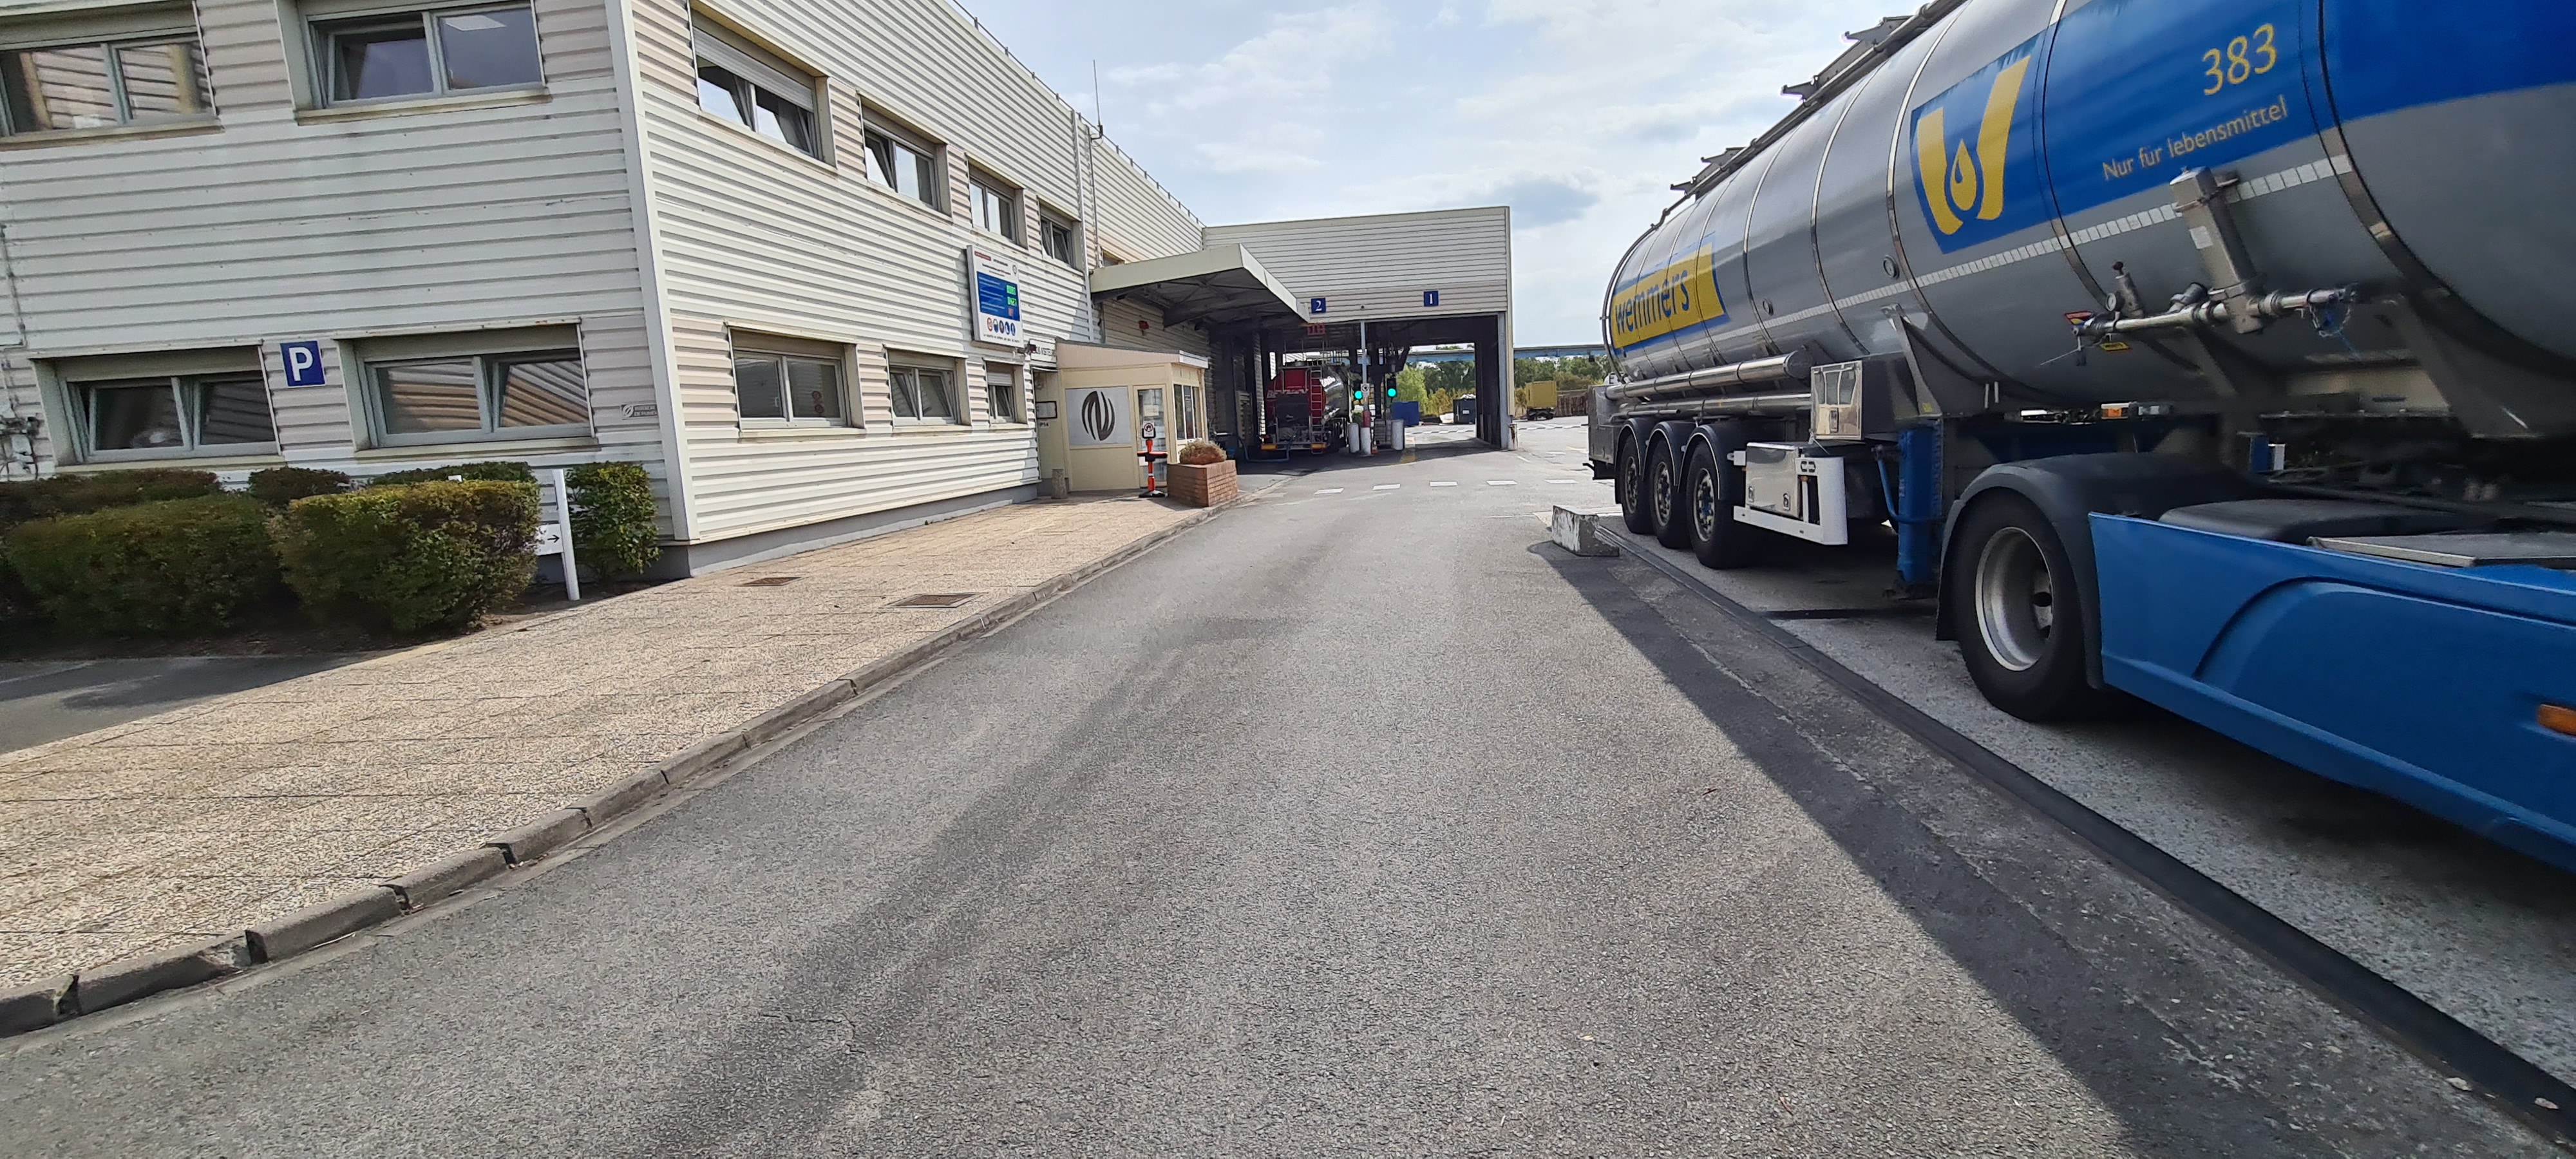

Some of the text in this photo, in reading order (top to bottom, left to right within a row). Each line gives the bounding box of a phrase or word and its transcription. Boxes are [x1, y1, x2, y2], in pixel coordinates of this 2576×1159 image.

[2202, 23, 2277, 96] 383
[2102, 93, 2288, 180] Nur für lebensmittel
[1315, 300, 1323, 312] 2
[1615, 269, 1690, 335] wemmers
[289, 346, 314, 382] P
